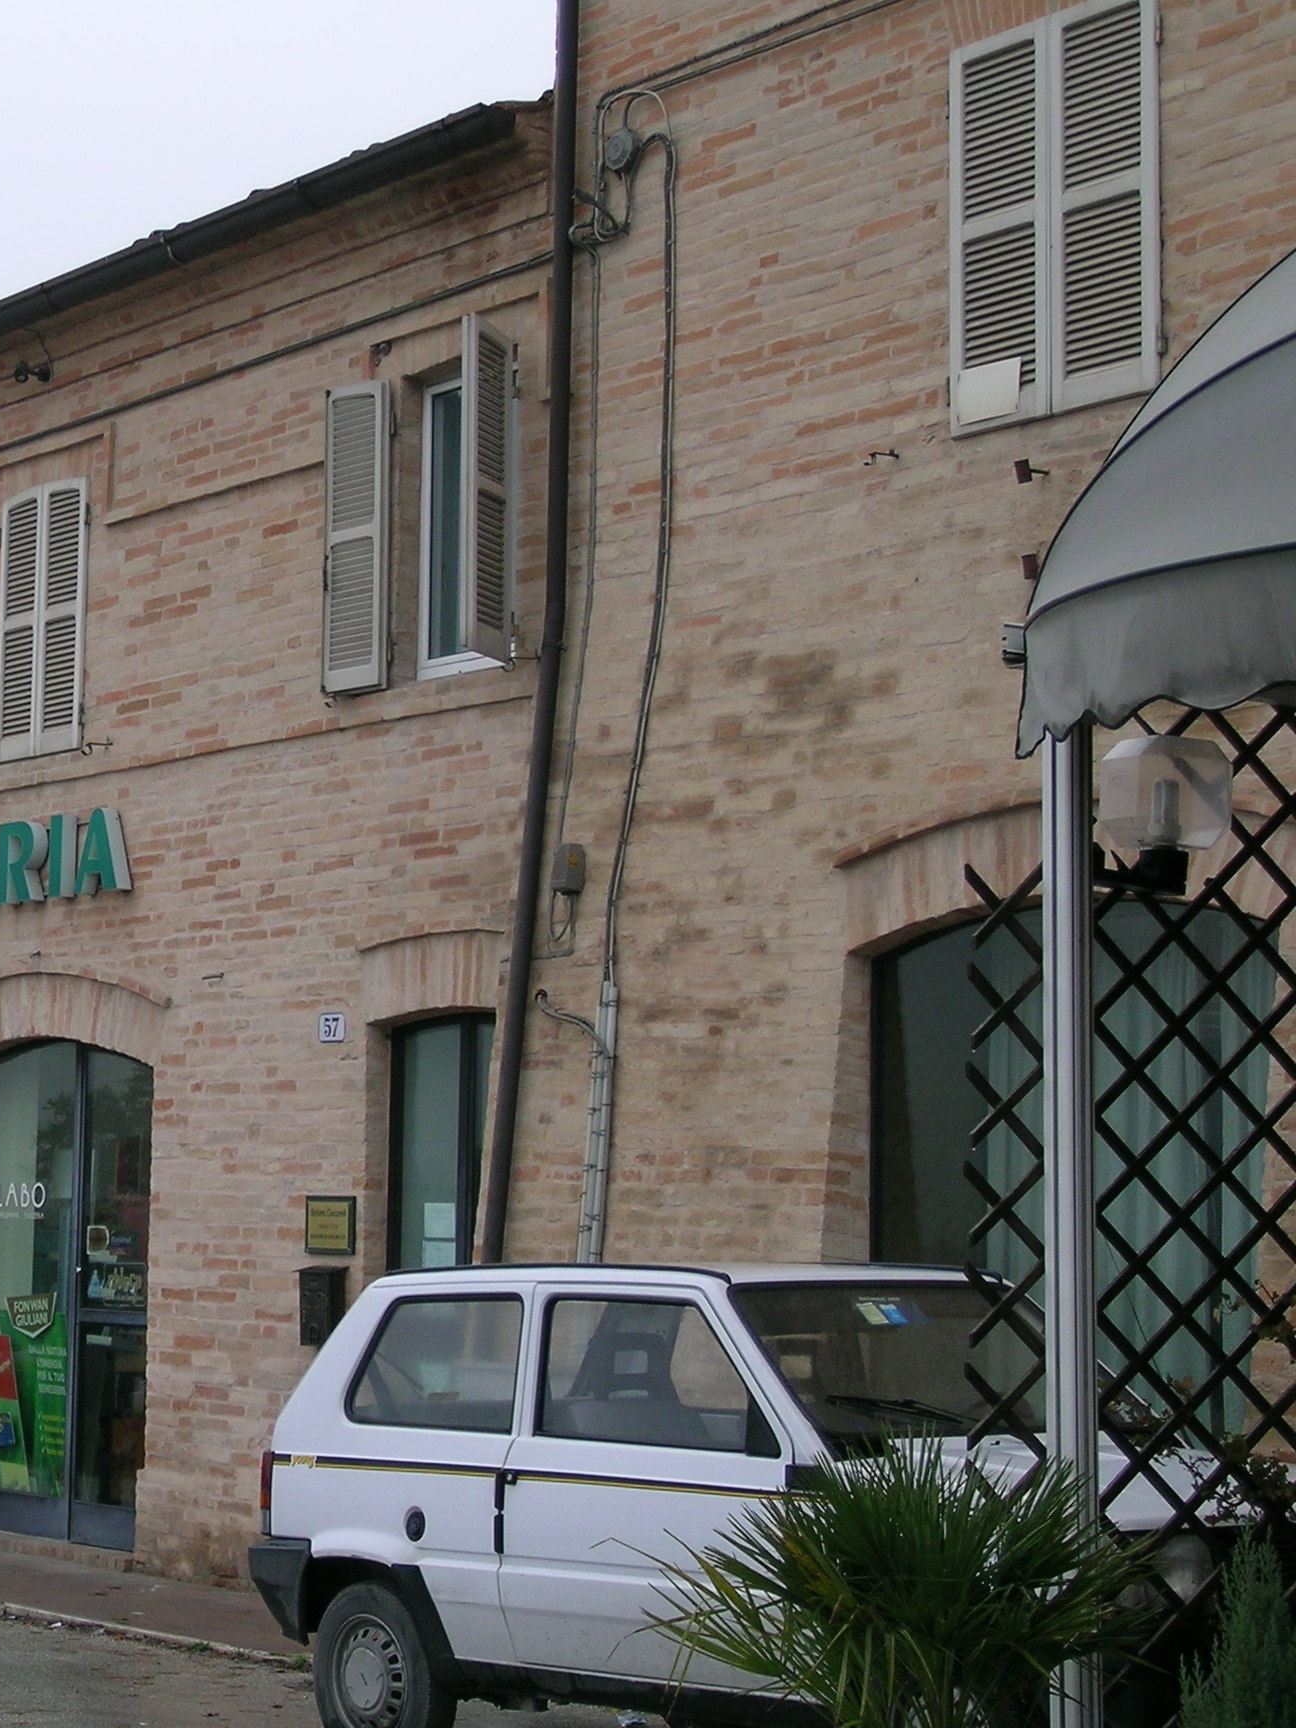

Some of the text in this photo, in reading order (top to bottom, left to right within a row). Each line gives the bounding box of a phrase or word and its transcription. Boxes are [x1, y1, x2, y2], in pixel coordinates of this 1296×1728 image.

[324, 1017, 340, 1038] 57
[13, 1298, 49, 1313] FONWAN
[15, 1312, 49, 1327] GIULIANI
